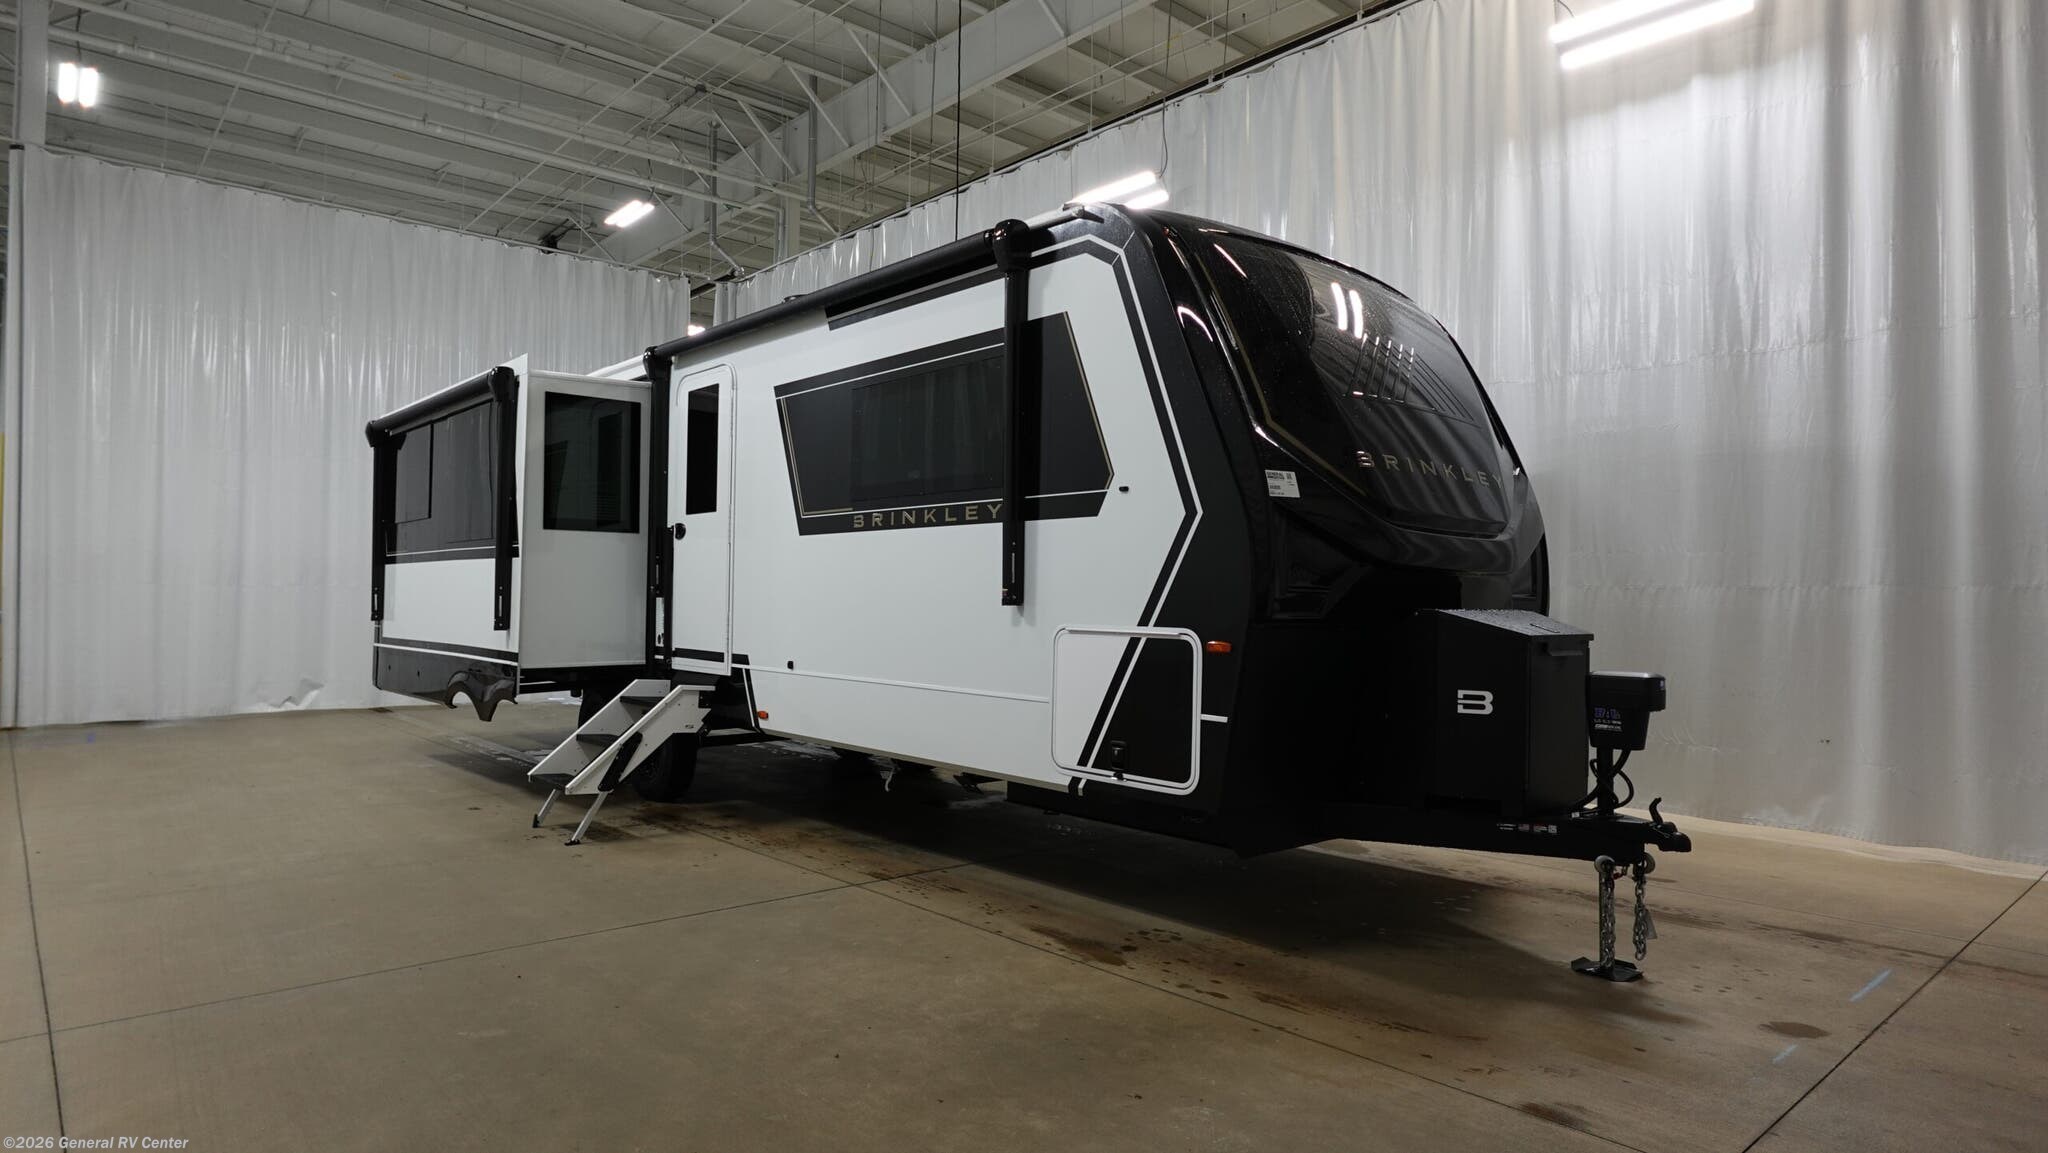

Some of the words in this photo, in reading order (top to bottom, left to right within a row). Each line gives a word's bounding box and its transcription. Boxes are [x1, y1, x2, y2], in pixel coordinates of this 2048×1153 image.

[1357, 450, 1503, 489] BRINKLEY
[853, 504, 1002, 528] BRINKLEY
[1457, 689, 1494, 715] B
